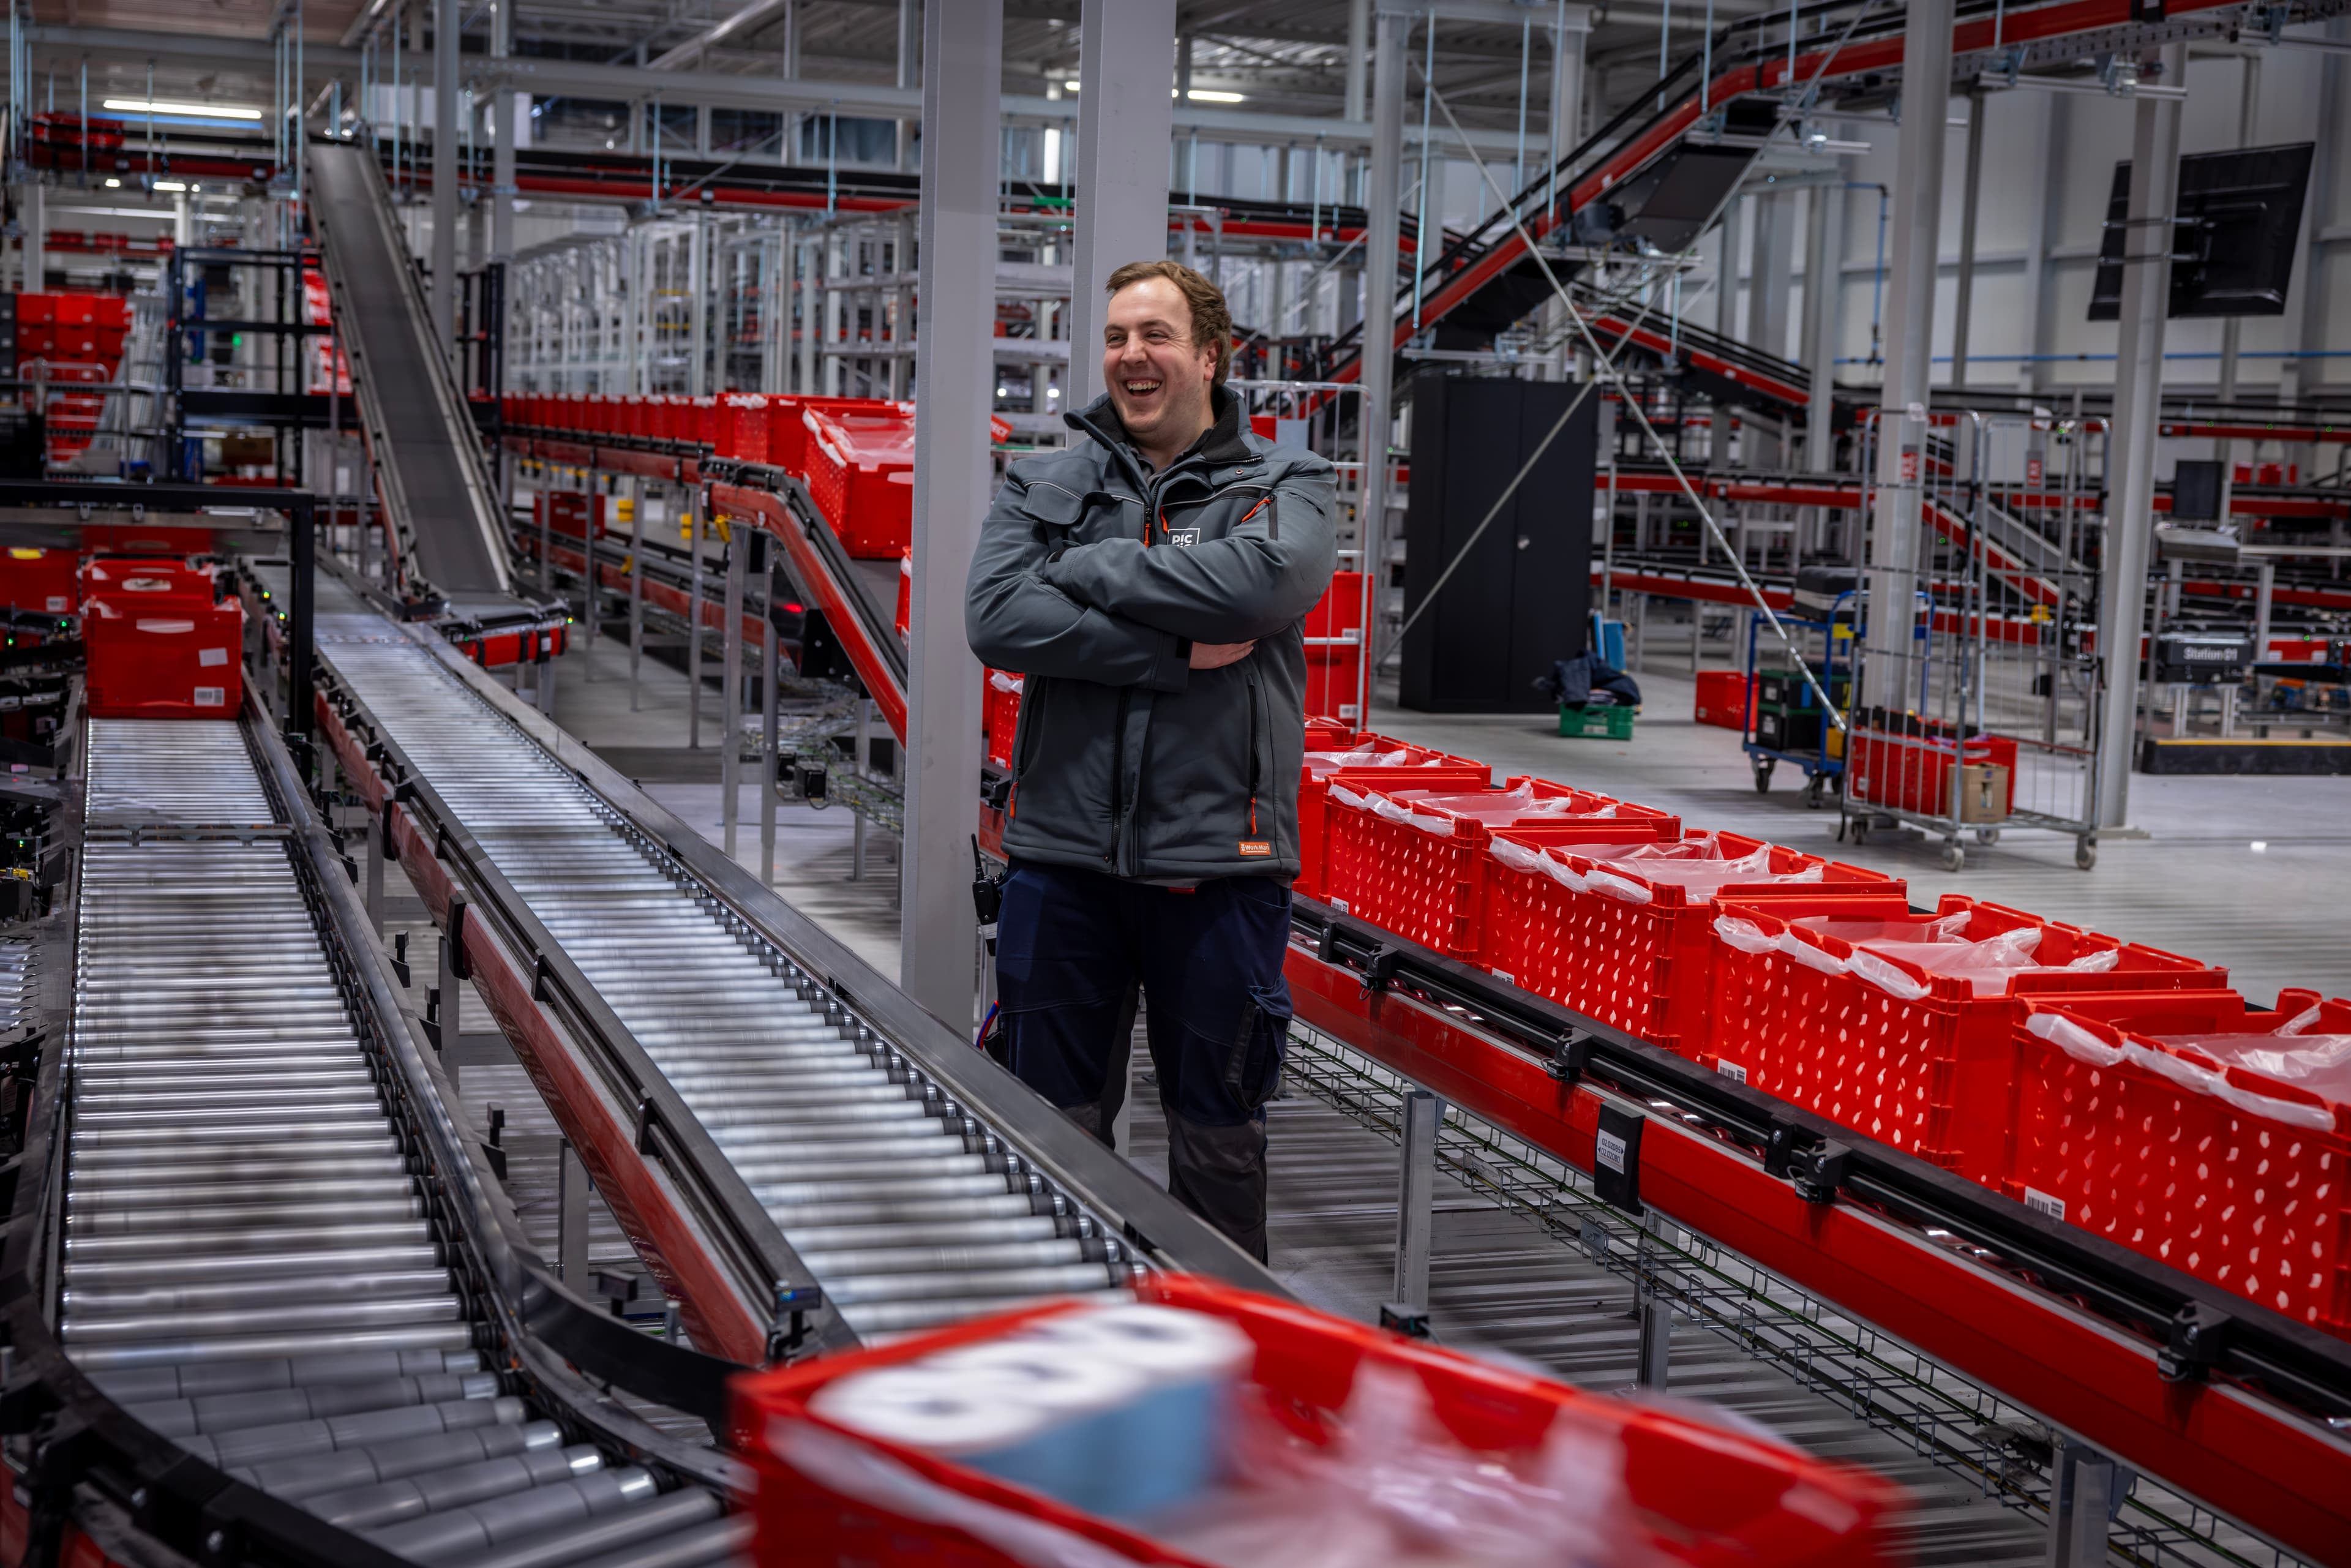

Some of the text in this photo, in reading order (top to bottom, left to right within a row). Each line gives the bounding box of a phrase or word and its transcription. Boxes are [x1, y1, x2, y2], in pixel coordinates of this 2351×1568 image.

[2183, 647, 2222, 661] Station
[1602, 1138, 1621, 1153] 02.02085
[1601, 1147, 1621, 1163] 02.02080
